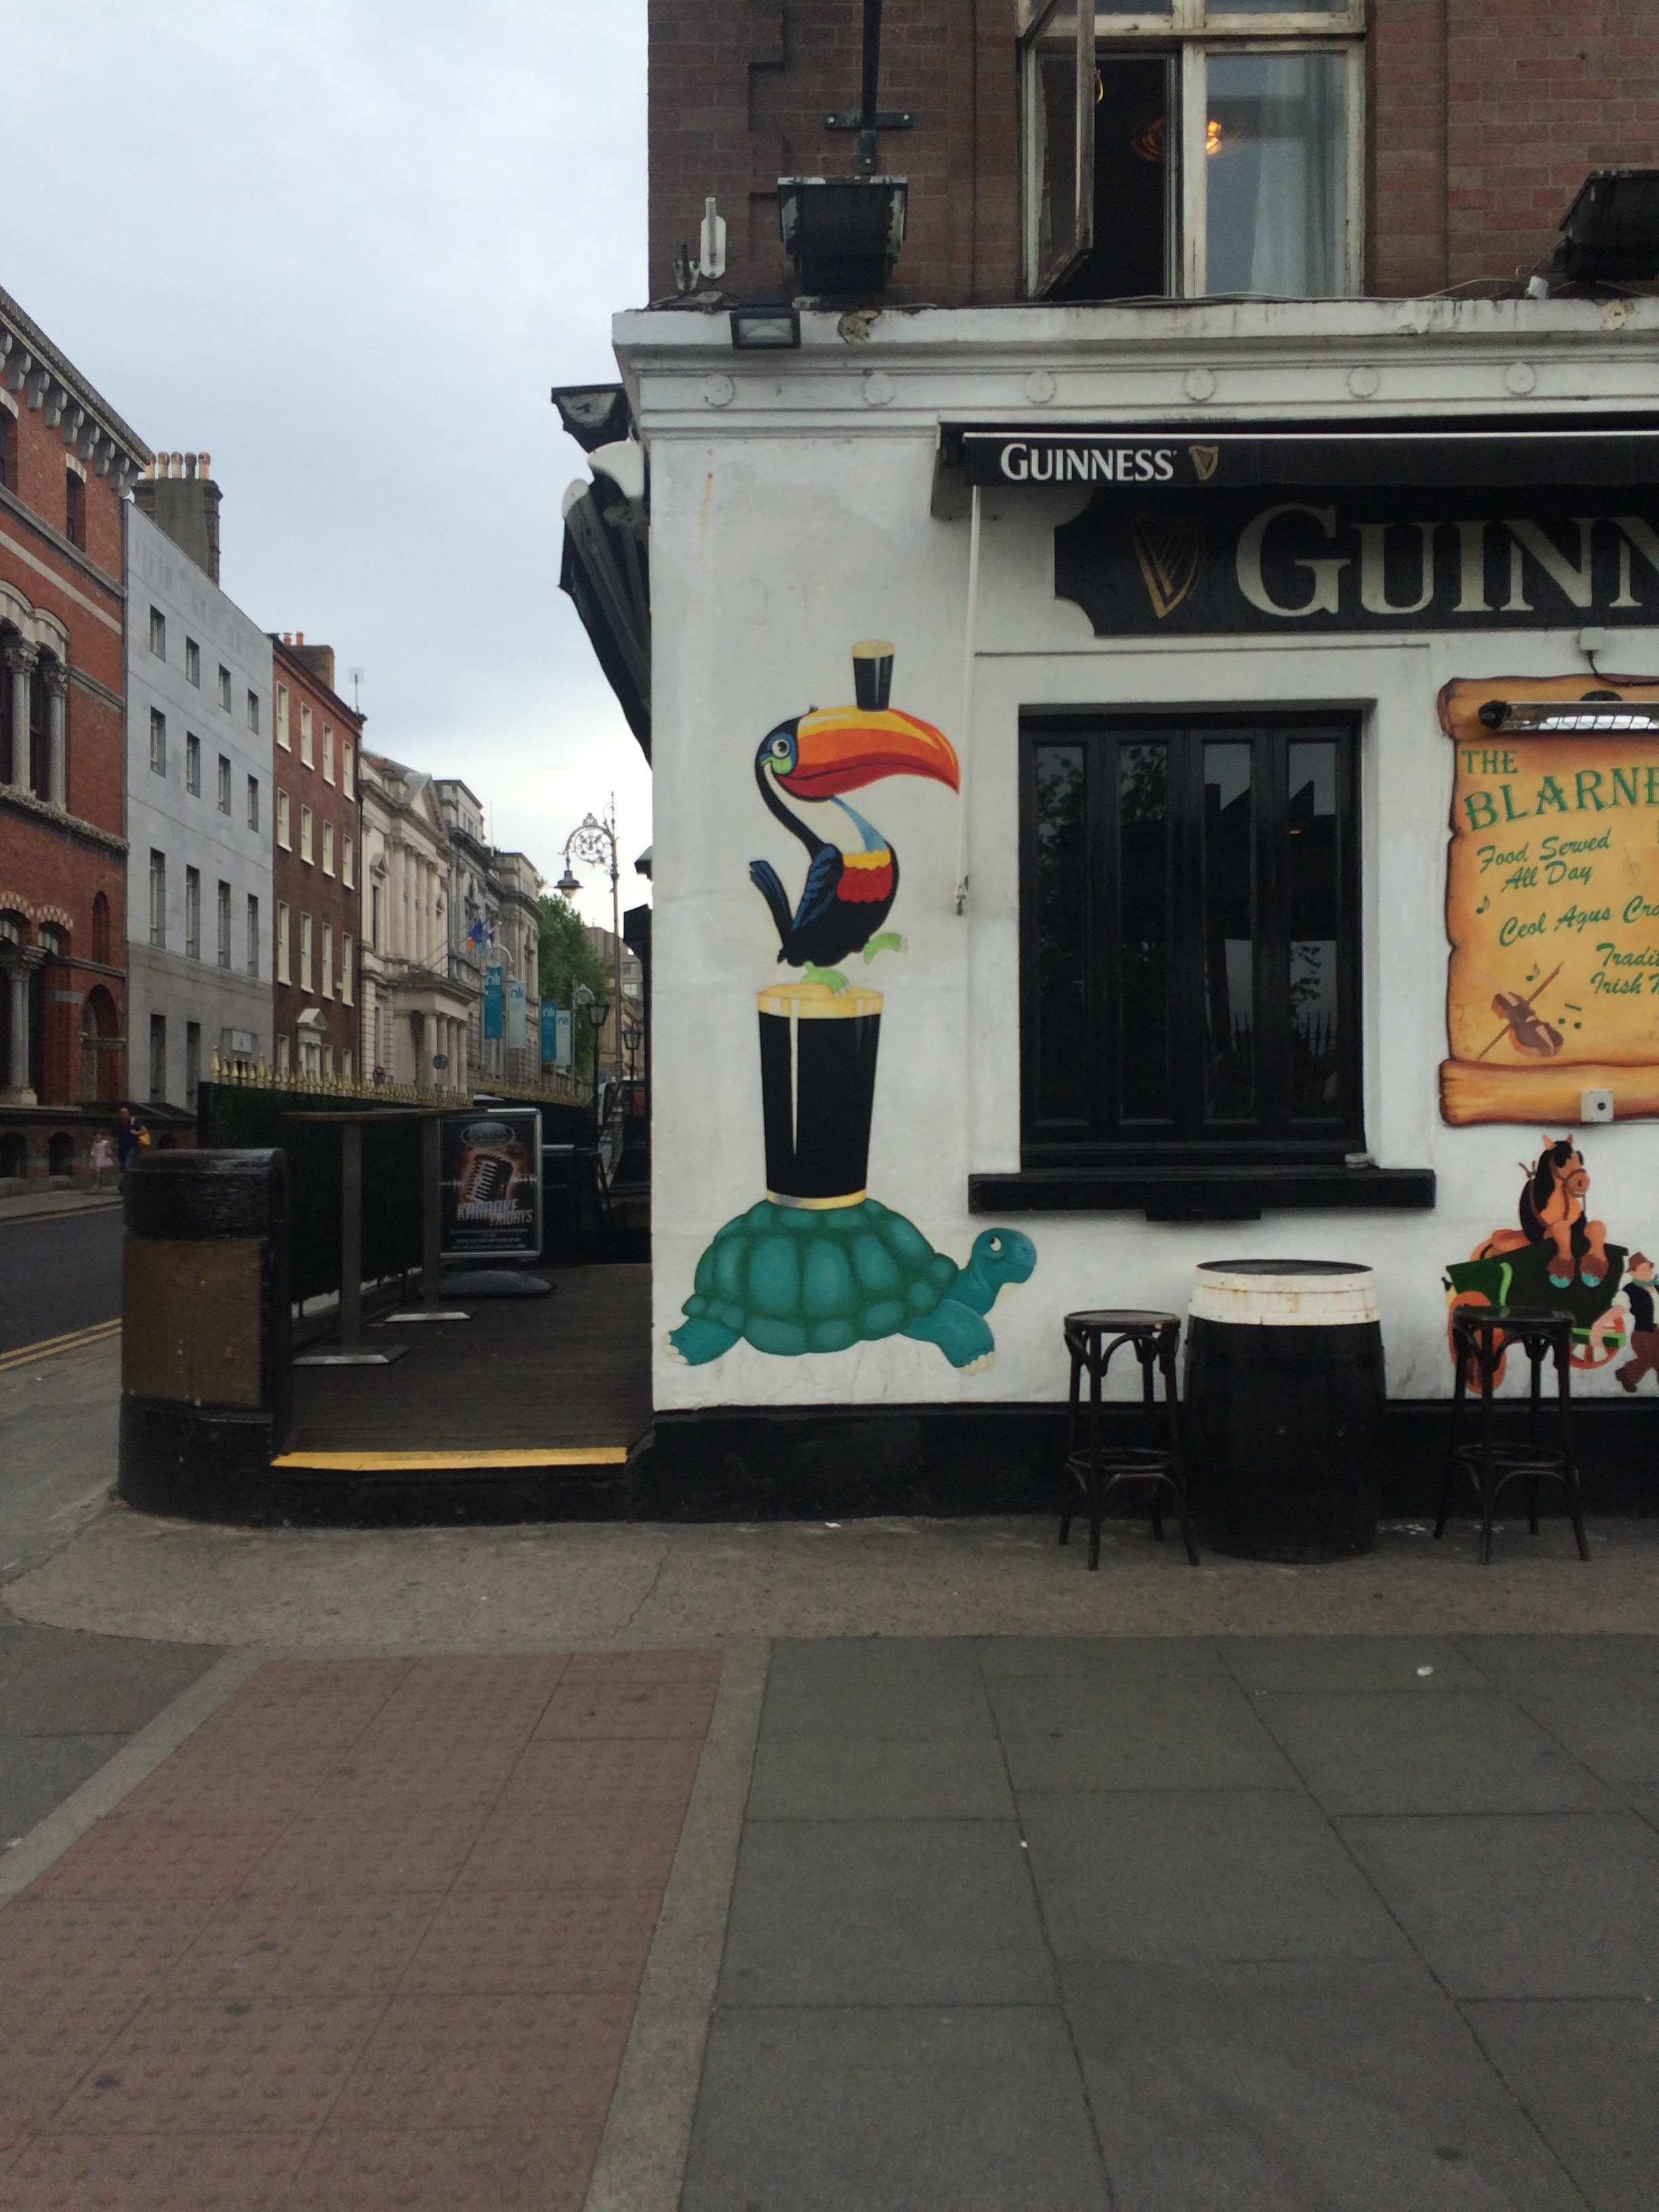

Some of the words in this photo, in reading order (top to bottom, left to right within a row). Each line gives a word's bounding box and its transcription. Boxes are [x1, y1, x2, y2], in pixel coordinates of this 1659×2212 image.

[1001, 443, 1174, 482] GUINNESS
[1461, 749, 1519, 775] THE
[1476, 842, 1529, 874] Food
[1539, 828, 1611, 861] Served
[1500, 865, 1538, 893] All
[1545, 860, 1592, 885] Day
[1498, 912, 1547, 947] Ceol
[1553, 905, 1612, 933] Agus
[1590, 971, 1645, 995] Irish
